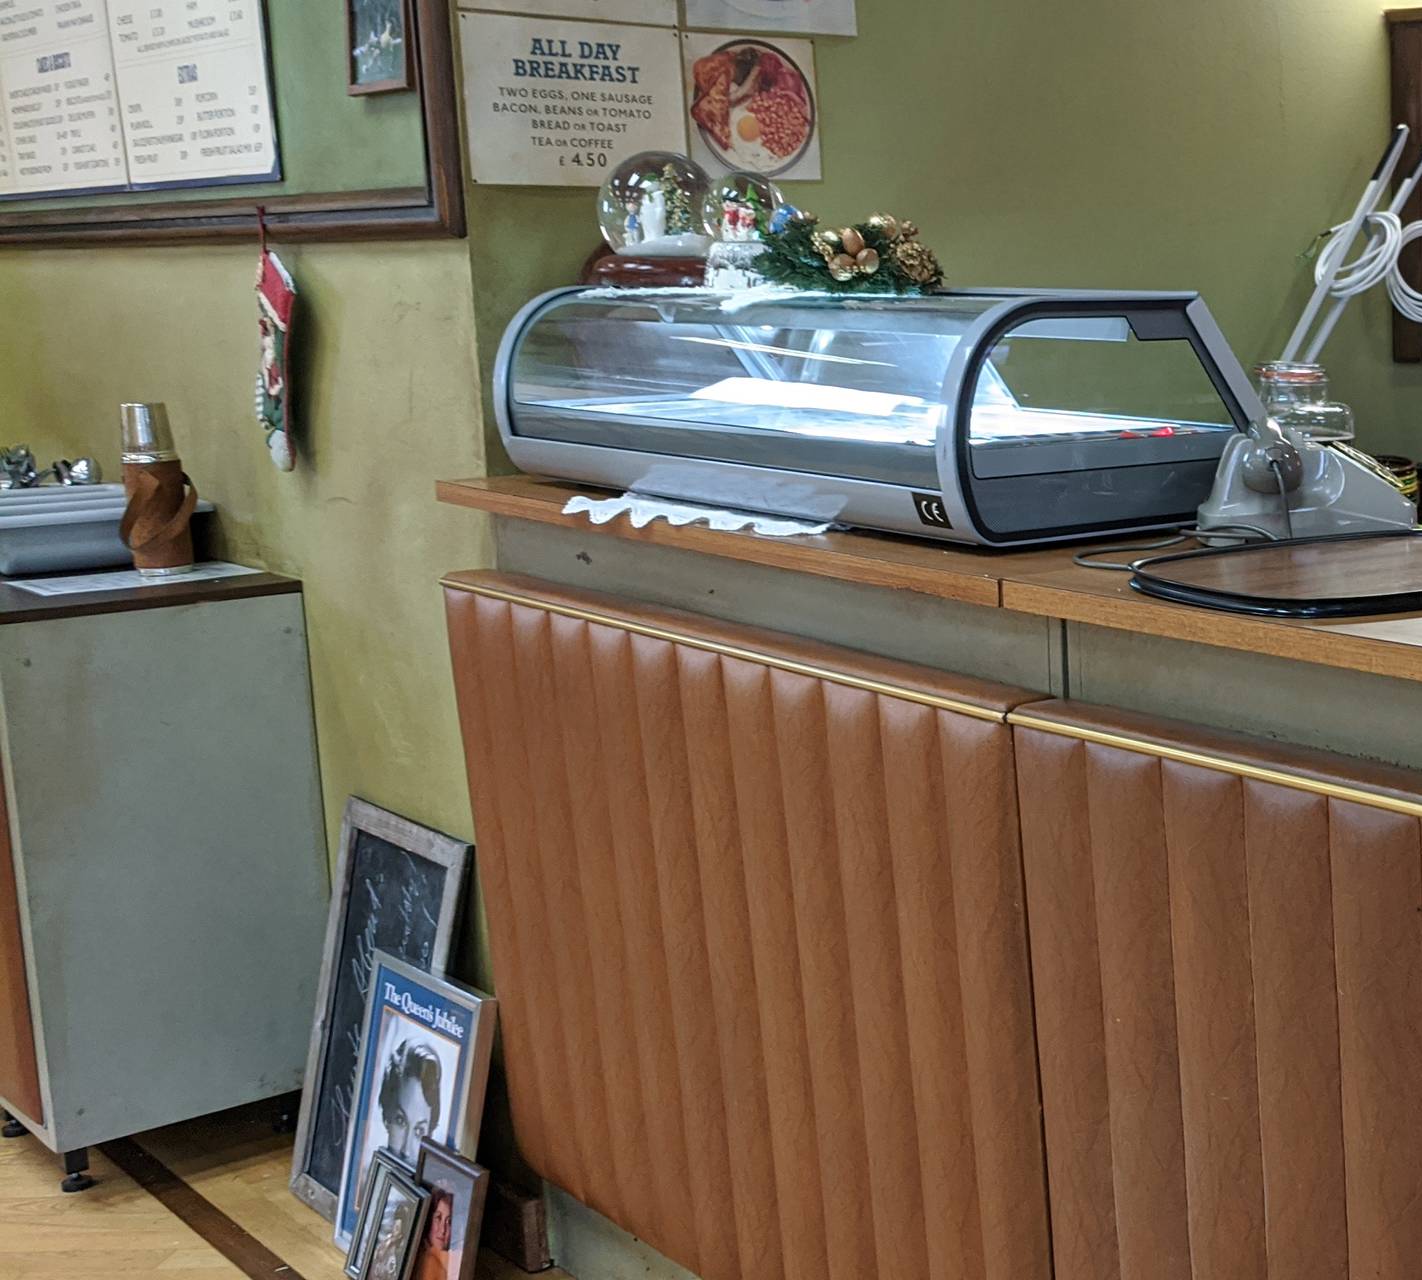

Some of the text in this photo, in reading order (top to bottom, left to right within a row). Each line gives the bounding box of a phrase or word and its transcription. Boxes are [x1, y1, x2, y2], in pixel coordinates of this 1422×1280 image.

[530, 38, 621, 61] ALL DAY
[512, 58, 640, 84] BREAKFAST
[498, 86, 528, 98] TWO
[571, 91, 597, 102] ONE
[600, 92, 653, 105] SAUSAGE
[545, 105, 583, 116] BEANS
[602, 107, 652, 119] TOMATO
[531, 119, 570, 131] BREAD
[589, 121, 627, 133] TOAST
[530, 136, 555, 147] TEA
[570, 137, 614, 149] COFFEE
[384, 982, 401, 1006] The
[432, 1007, 464, 1039] Jubilee
